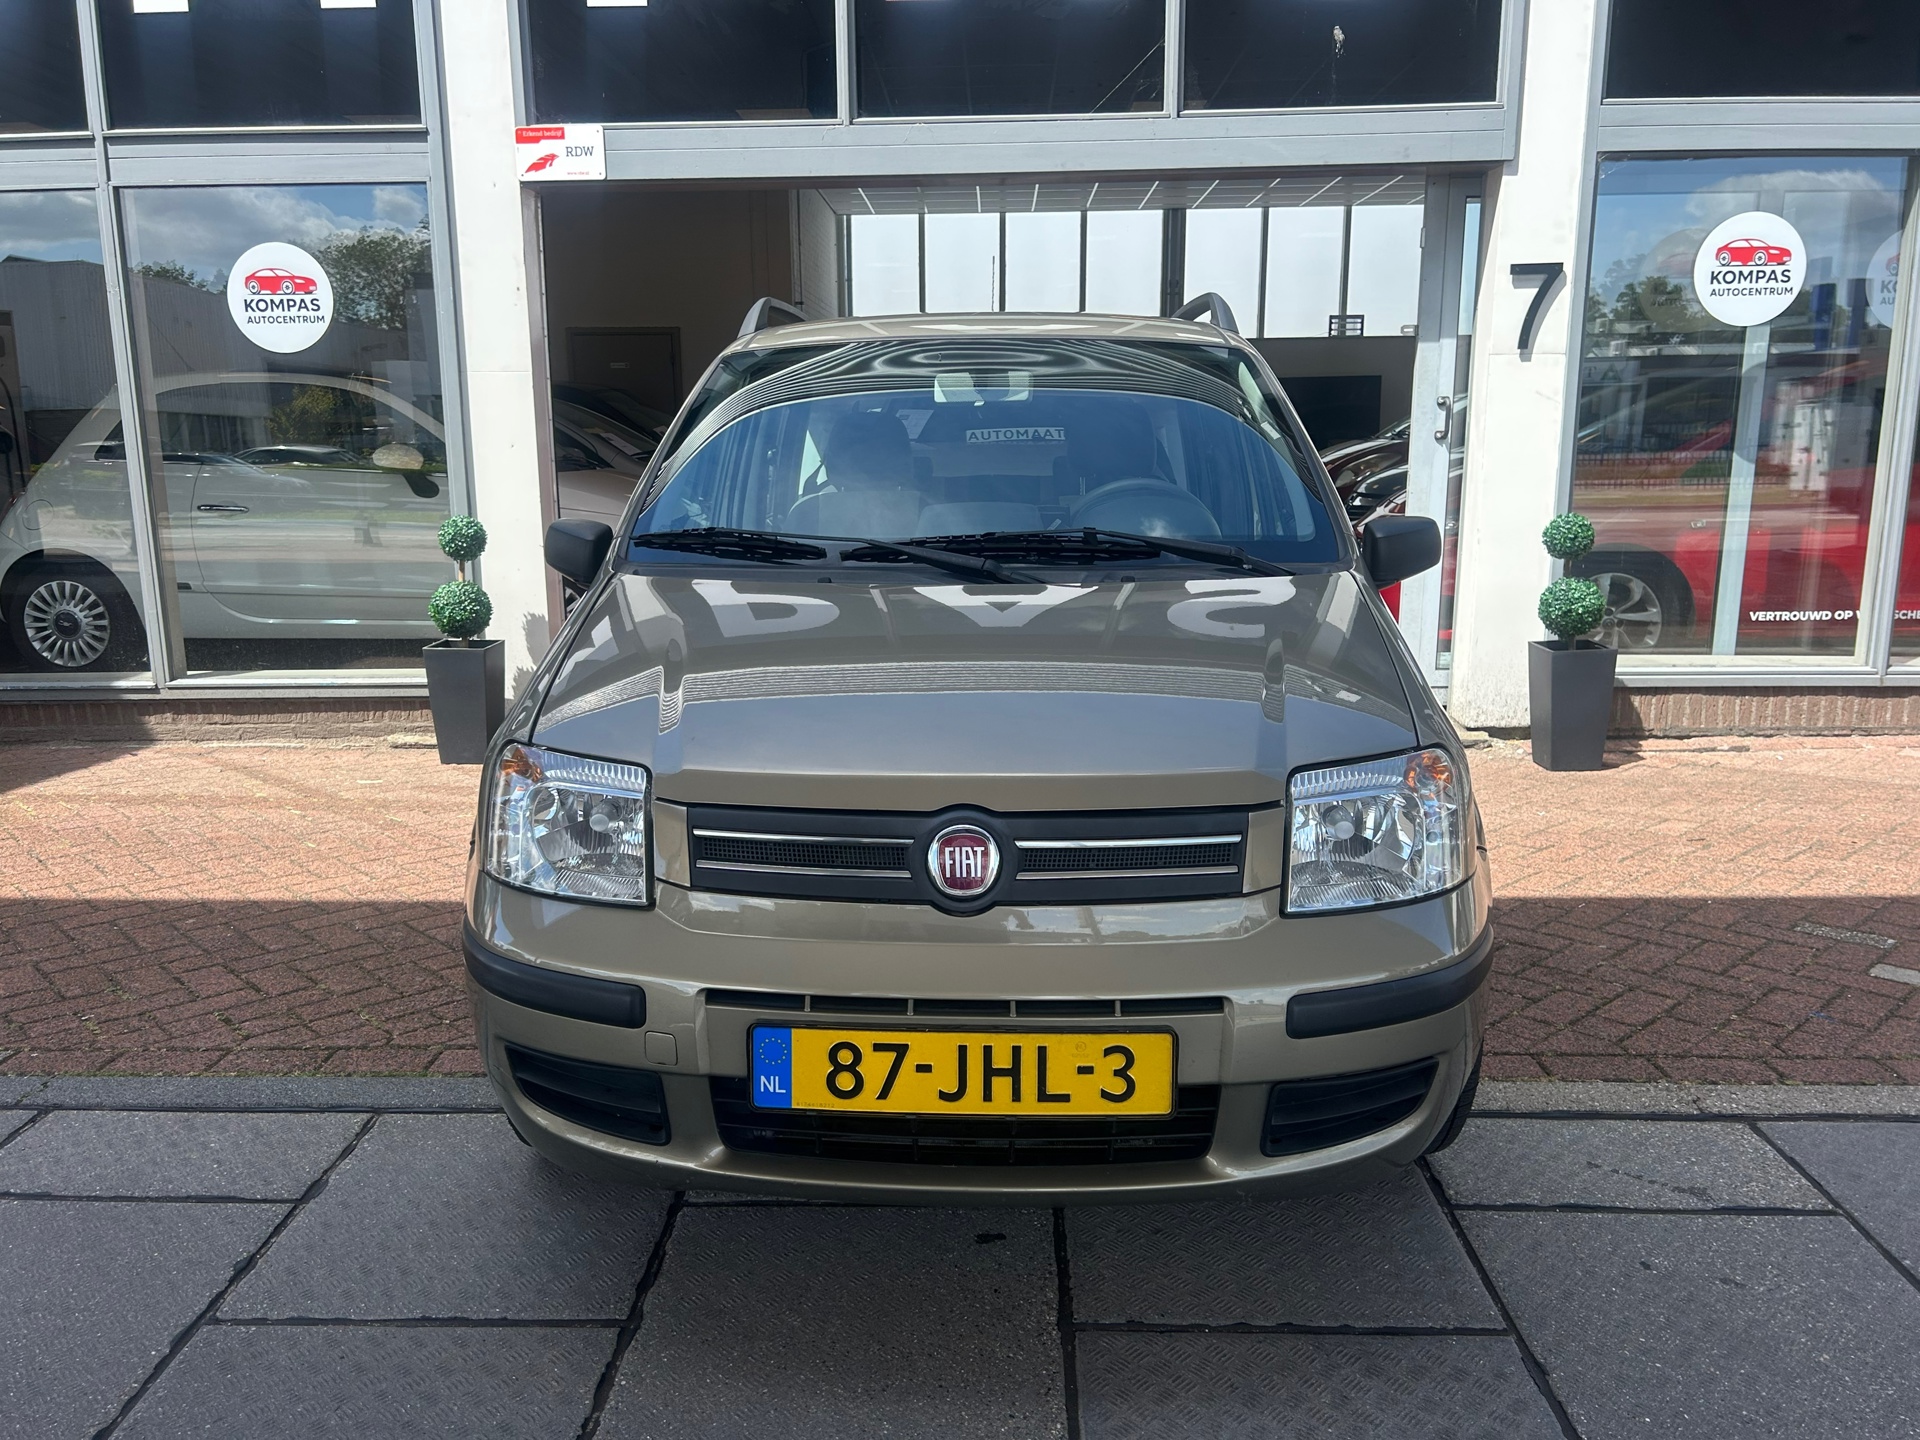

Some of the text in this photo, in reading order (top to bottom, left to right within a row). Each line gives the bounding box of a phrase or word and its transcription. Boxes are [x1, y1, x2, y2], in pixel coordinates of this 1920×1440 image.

[543, 129, 563, 138] bedrijf
[565, 146, 594, 157] RDW
[1710, 269, 1792, 285] KOMPAS
[1709, 286, 1794, 297] AUTOCENTRUM
[243, 298, 321, 312] KOMPAS
[1510, 262, 1564, 349] 7
[246, 315, 326, 324] AUTOCENTRUM
[967, 428, 1065, 441] AUTOMAAT
[1749, 610, 1832, 621] VERTROUWD
[1834, 610, 1854, 620] OP
[944, 846, 985, 878] FIAT
[825, 1040, 1137, 1103] 87-JHL-3
[760, 1075, 787, 1093] NL
